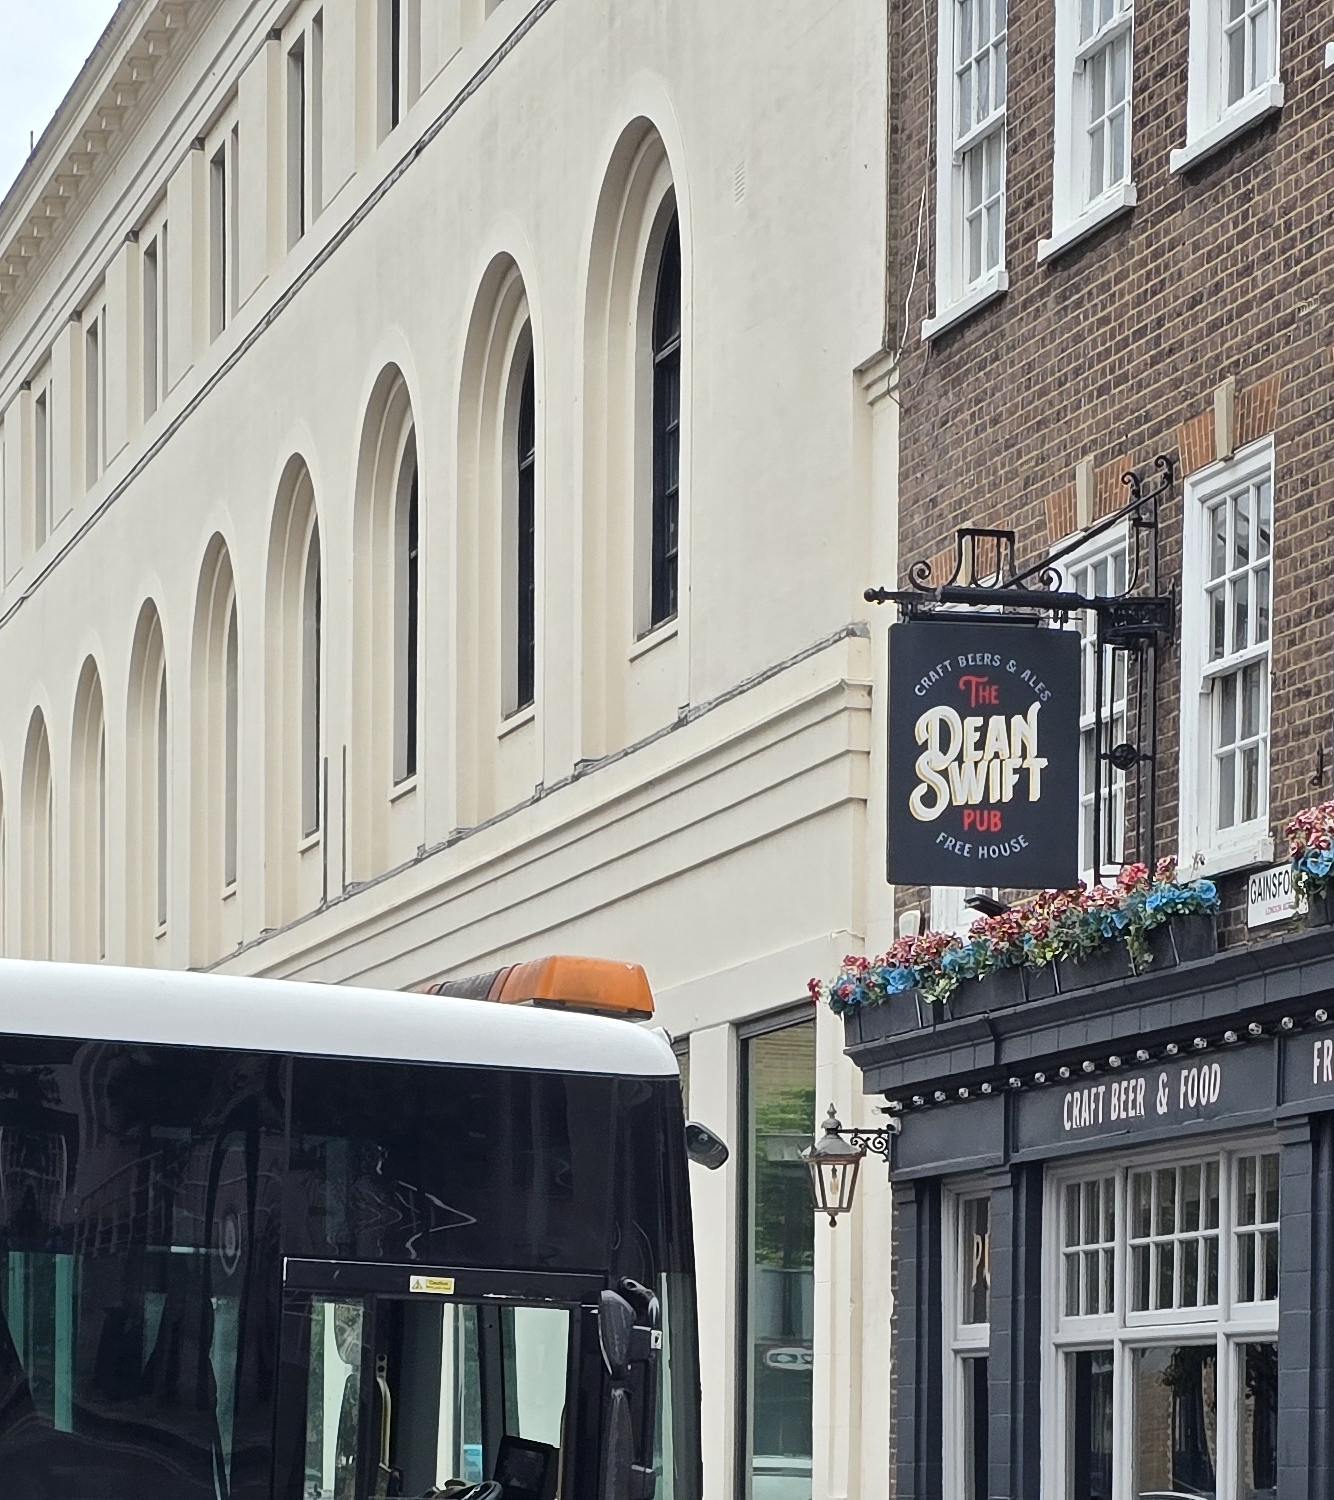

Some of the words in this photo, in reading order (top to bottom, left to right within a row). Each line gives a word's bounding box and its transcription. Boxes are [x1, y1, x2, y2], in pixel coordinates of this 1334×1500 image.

[915, 660, 952, 696] CRAFT
[958, 653, 1001, 668] BEERS
[1006, 660, 1017, 673] &
[1020, 669, 1051, 702] ALES
[915, 701, 1042, 771] DEAN
[909, 750, 1048, 822] SWIFT
[936, 832, 972, 858] FREE
[978, 834, 1029, 859] HOUSE
[963, 809, 1002, 832] PUB
[1063, 1085, 1105, 1130] CRAFT
[1110, 1077, 1146, 1121] BEER
[1156, 1072, 1169, 1115] &
[1179, 1063, 1221, 1110] FOOD
